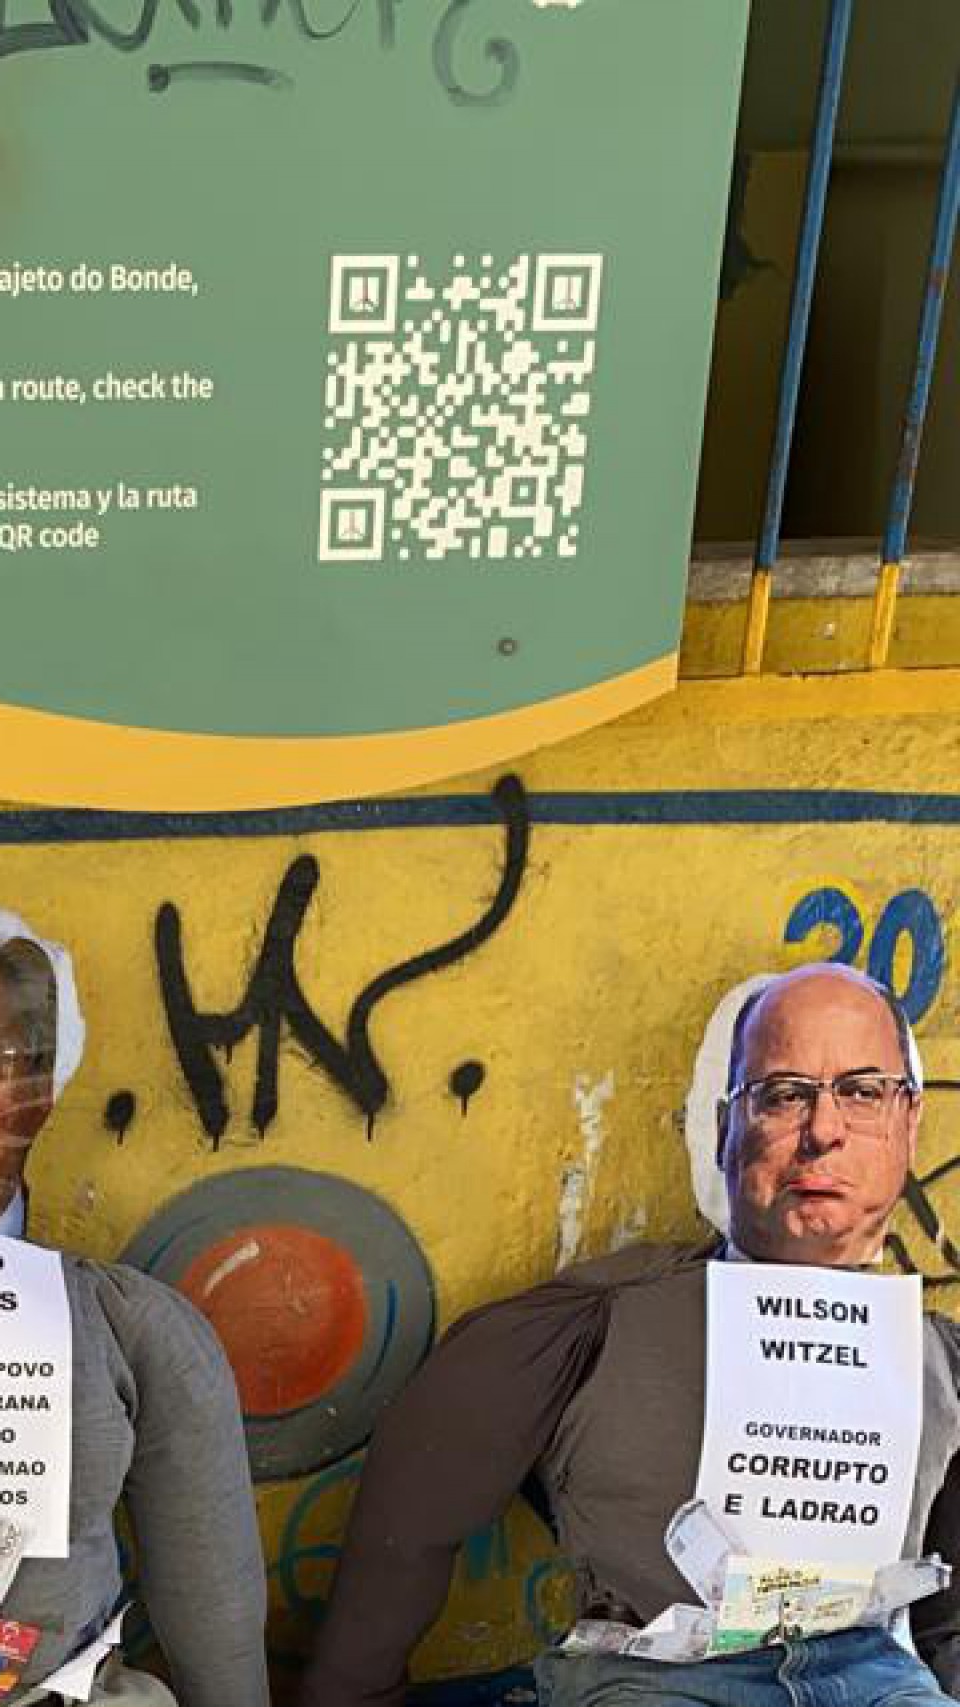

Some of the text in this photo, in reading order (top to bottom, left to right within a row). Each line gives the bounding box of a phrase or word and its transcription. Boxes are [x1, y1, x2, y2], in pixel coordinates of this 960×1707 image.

[70, 264, 104, 291] do
[112, 264, 197, 296] Bonde,
[13, 376, 85, 403] route,
[93, 373, 165, 398] check
[171, 373, 213, 398] the
[96, 491, 112, 515] y
[118, 483, 139, 507] la
[147, 486, 197, 507] ruta
[40, 522, 99, 547] code
[756, 1295, 868, 1324] WILSON
[759, 1338, 868, 1369] WITZEL
[745, 1421, 881, 1447] GOVERNADOR
[727, 1452, 889, 1486] CORRUPTO
[722, 1493, 879, 1527] E LADRAO
